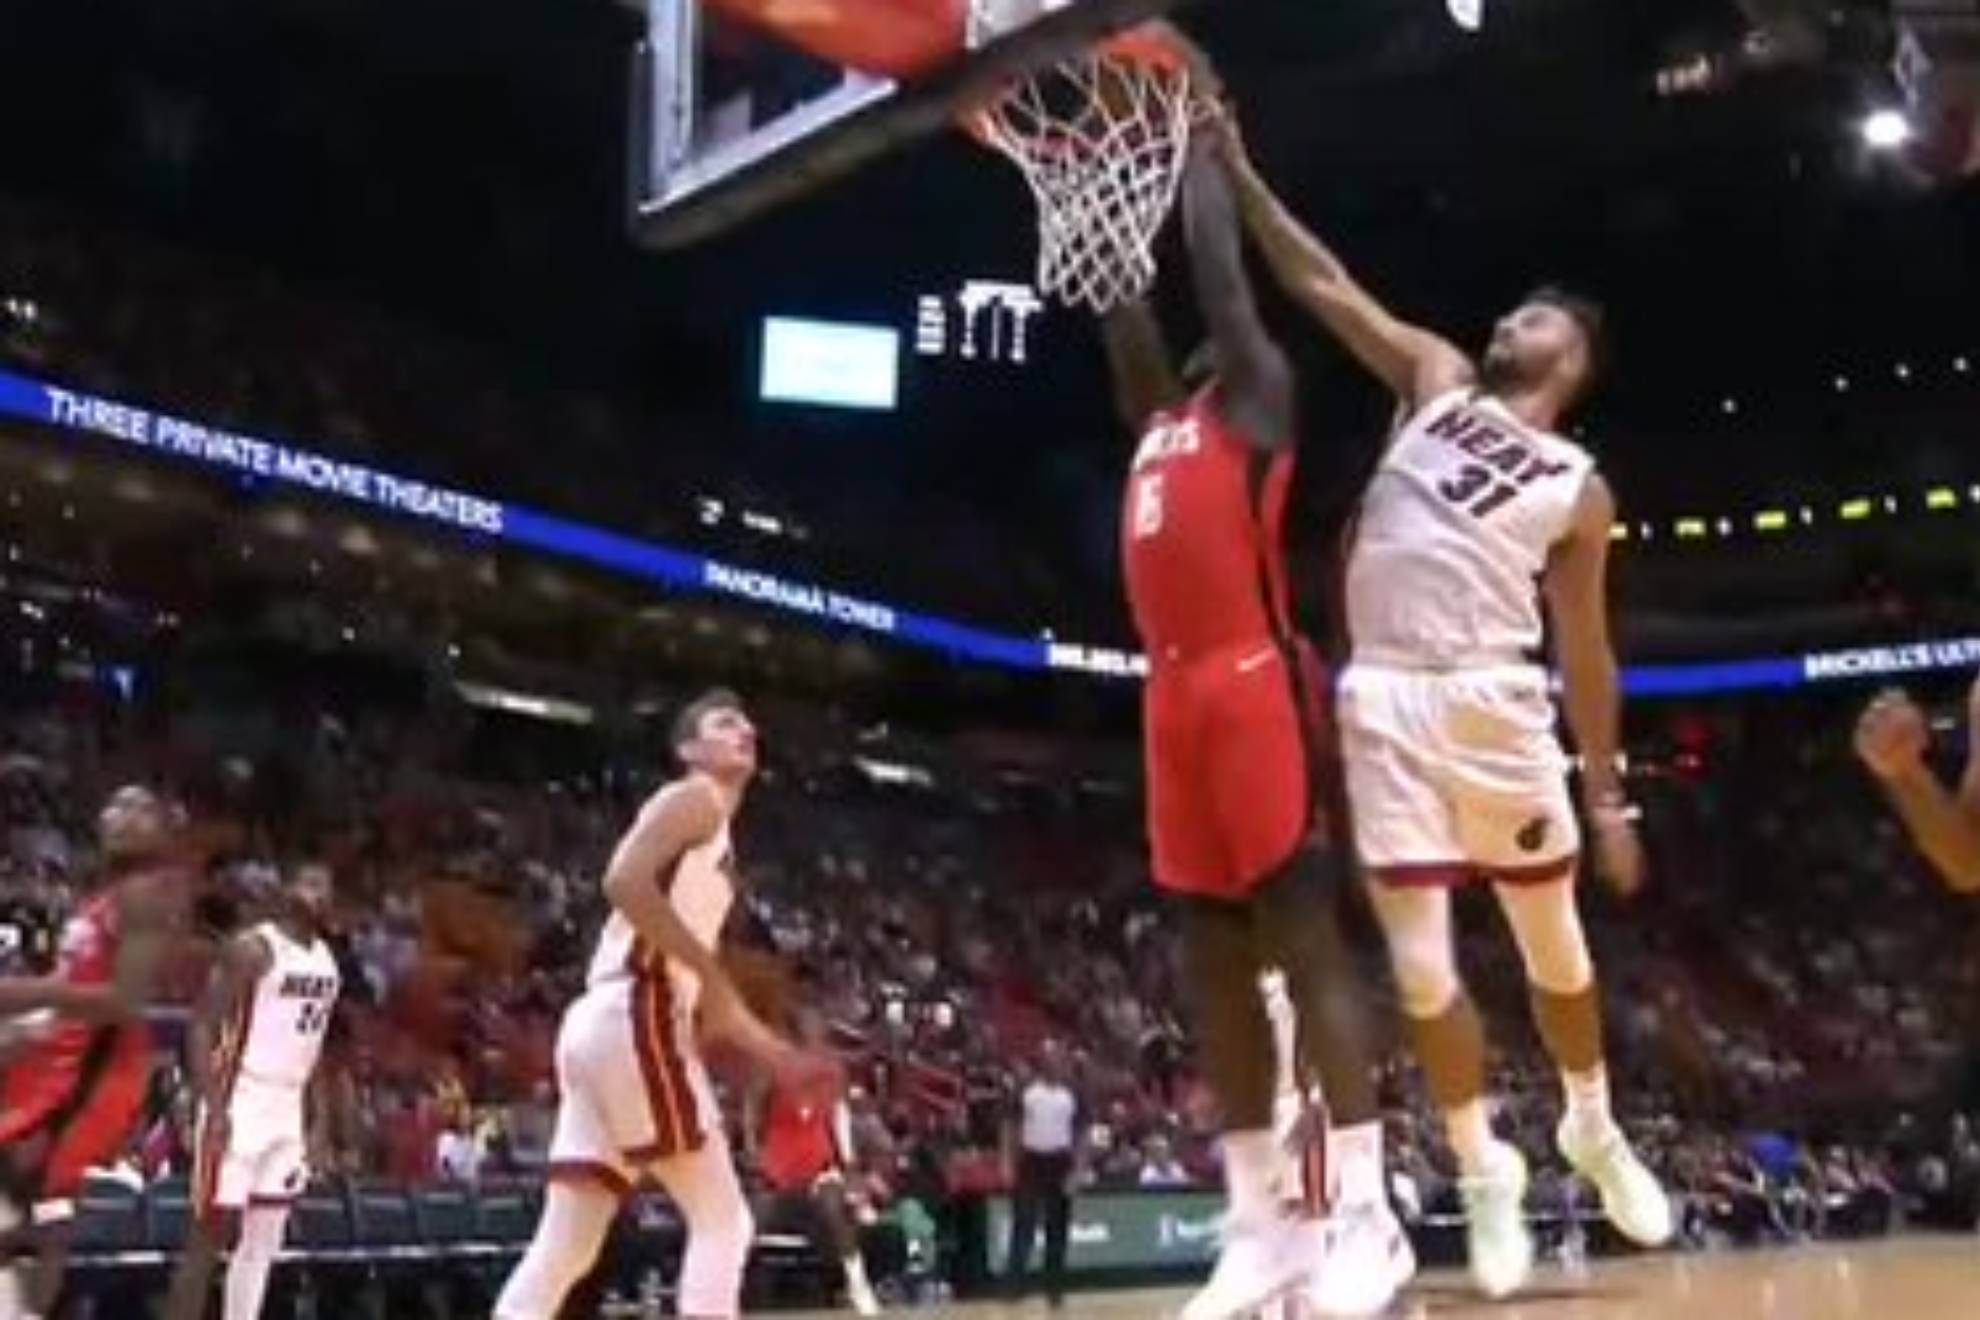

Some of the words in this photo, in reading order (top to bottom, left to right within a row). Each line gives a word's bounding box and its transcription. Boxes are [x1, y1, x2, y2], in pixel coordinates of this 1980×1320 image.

[45, 387, 149, 444] THREE
[155, 415, 272, 477] PRIVATE
[278, 446, 370, 500] MOVIE
[374, 473, 502, 533] THEATERS
[1425, 411, 1570, 484] HEAT
[1438, 464, 1516, 518] 31
[704, 560, 824, 615] PANORAMA
[827, 593, 896, 632] TOWER
